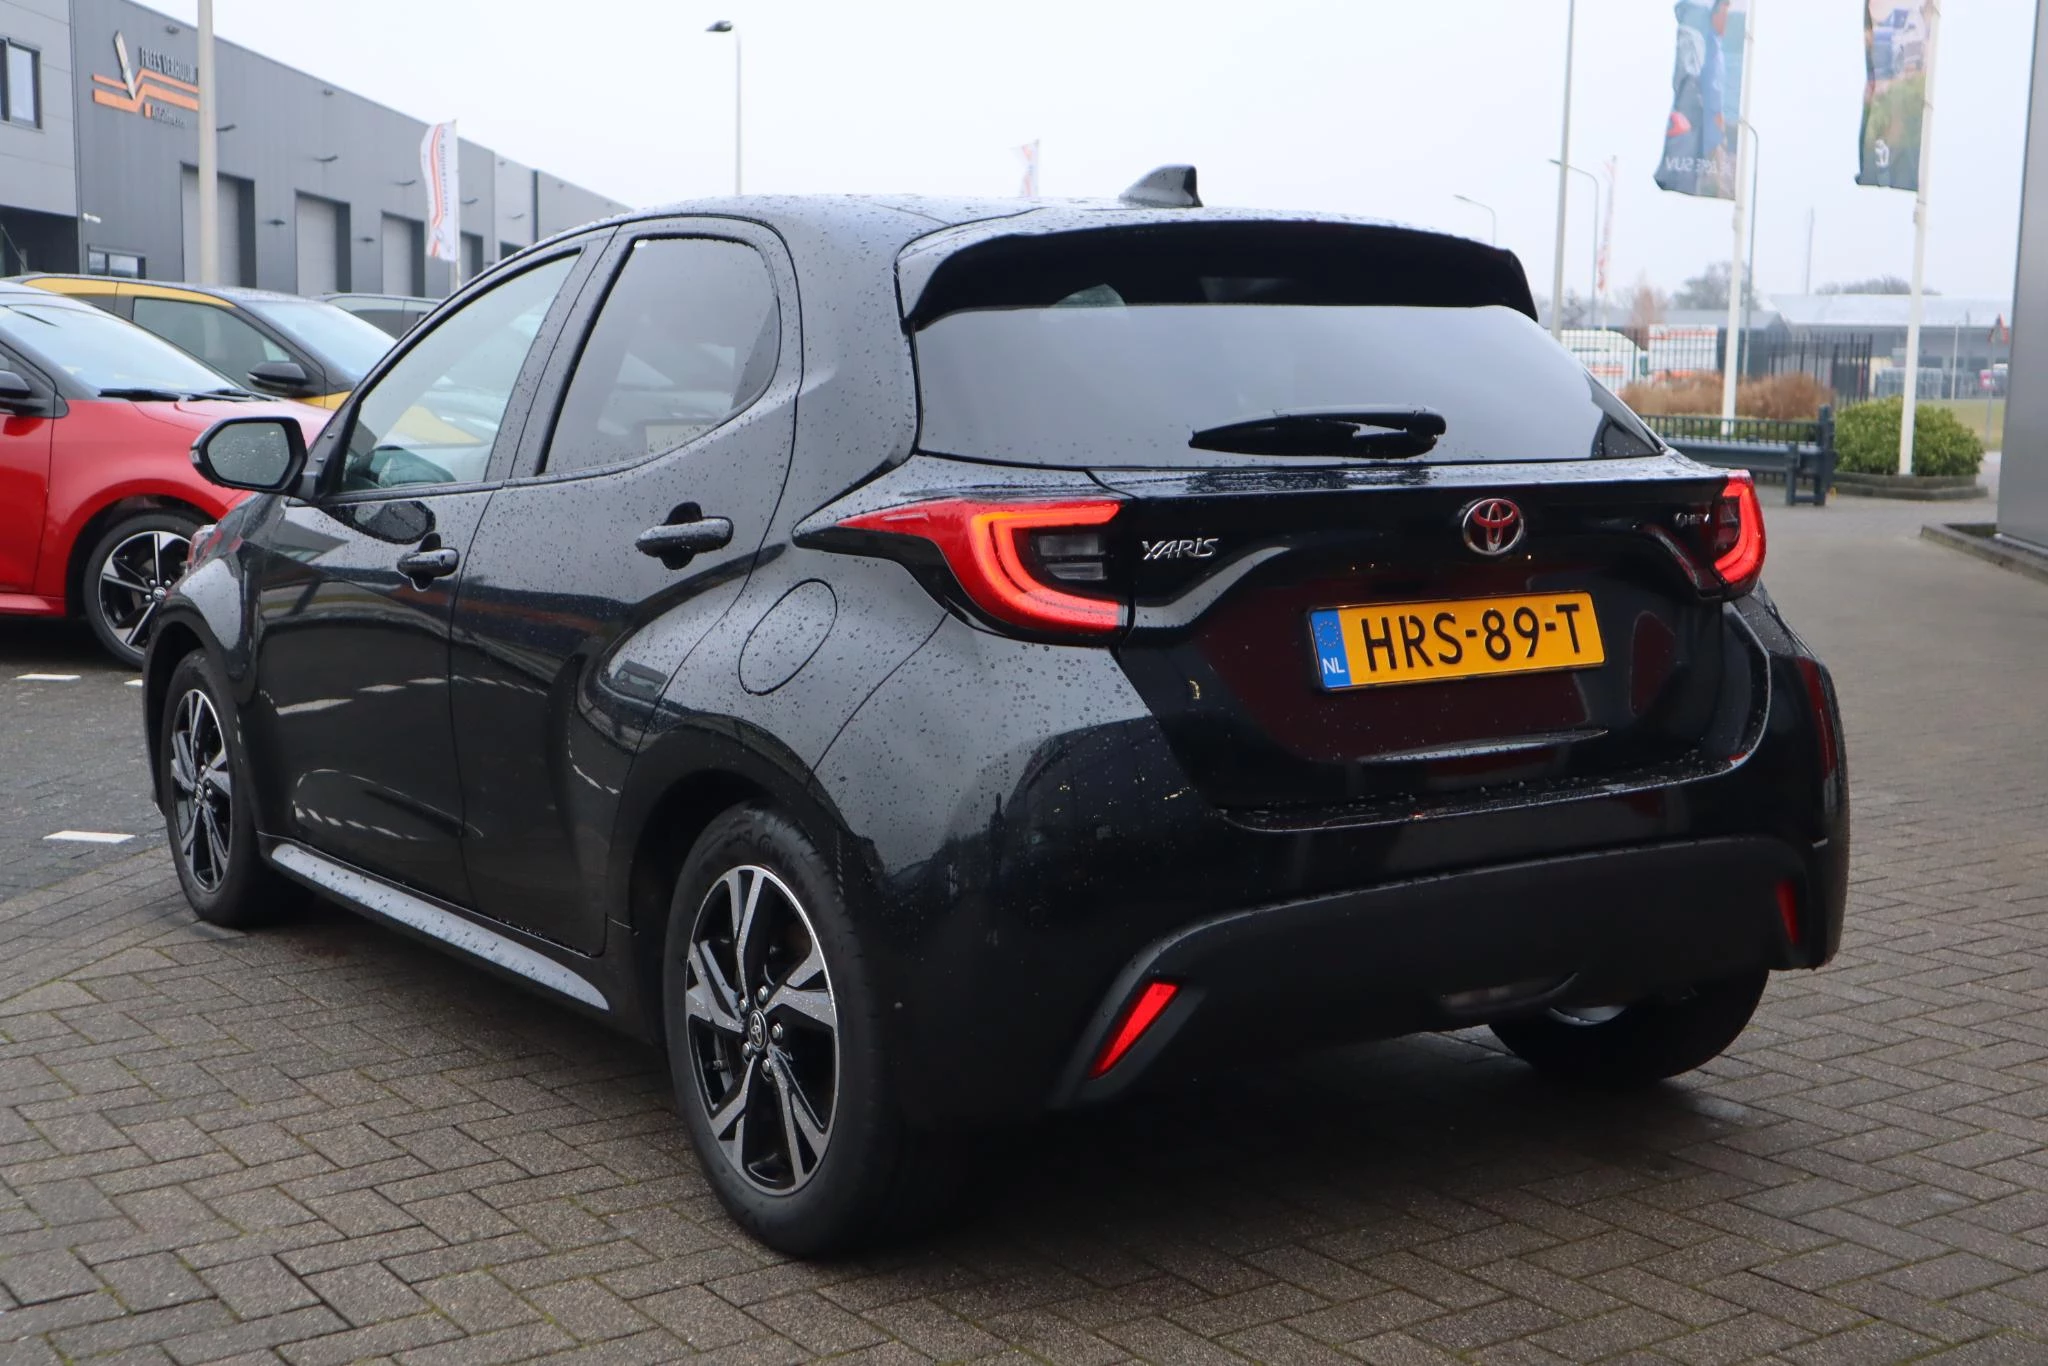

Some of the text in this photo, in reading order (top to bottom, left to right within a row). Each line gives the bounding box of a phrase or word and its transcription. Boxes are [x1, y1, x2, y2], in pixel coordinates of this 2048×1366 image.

[1142, 537, 1219, 560] YARIS
[1361, 603, 1580, 672] HRS-89-T
[1322, 656, 1345, 674] NL
